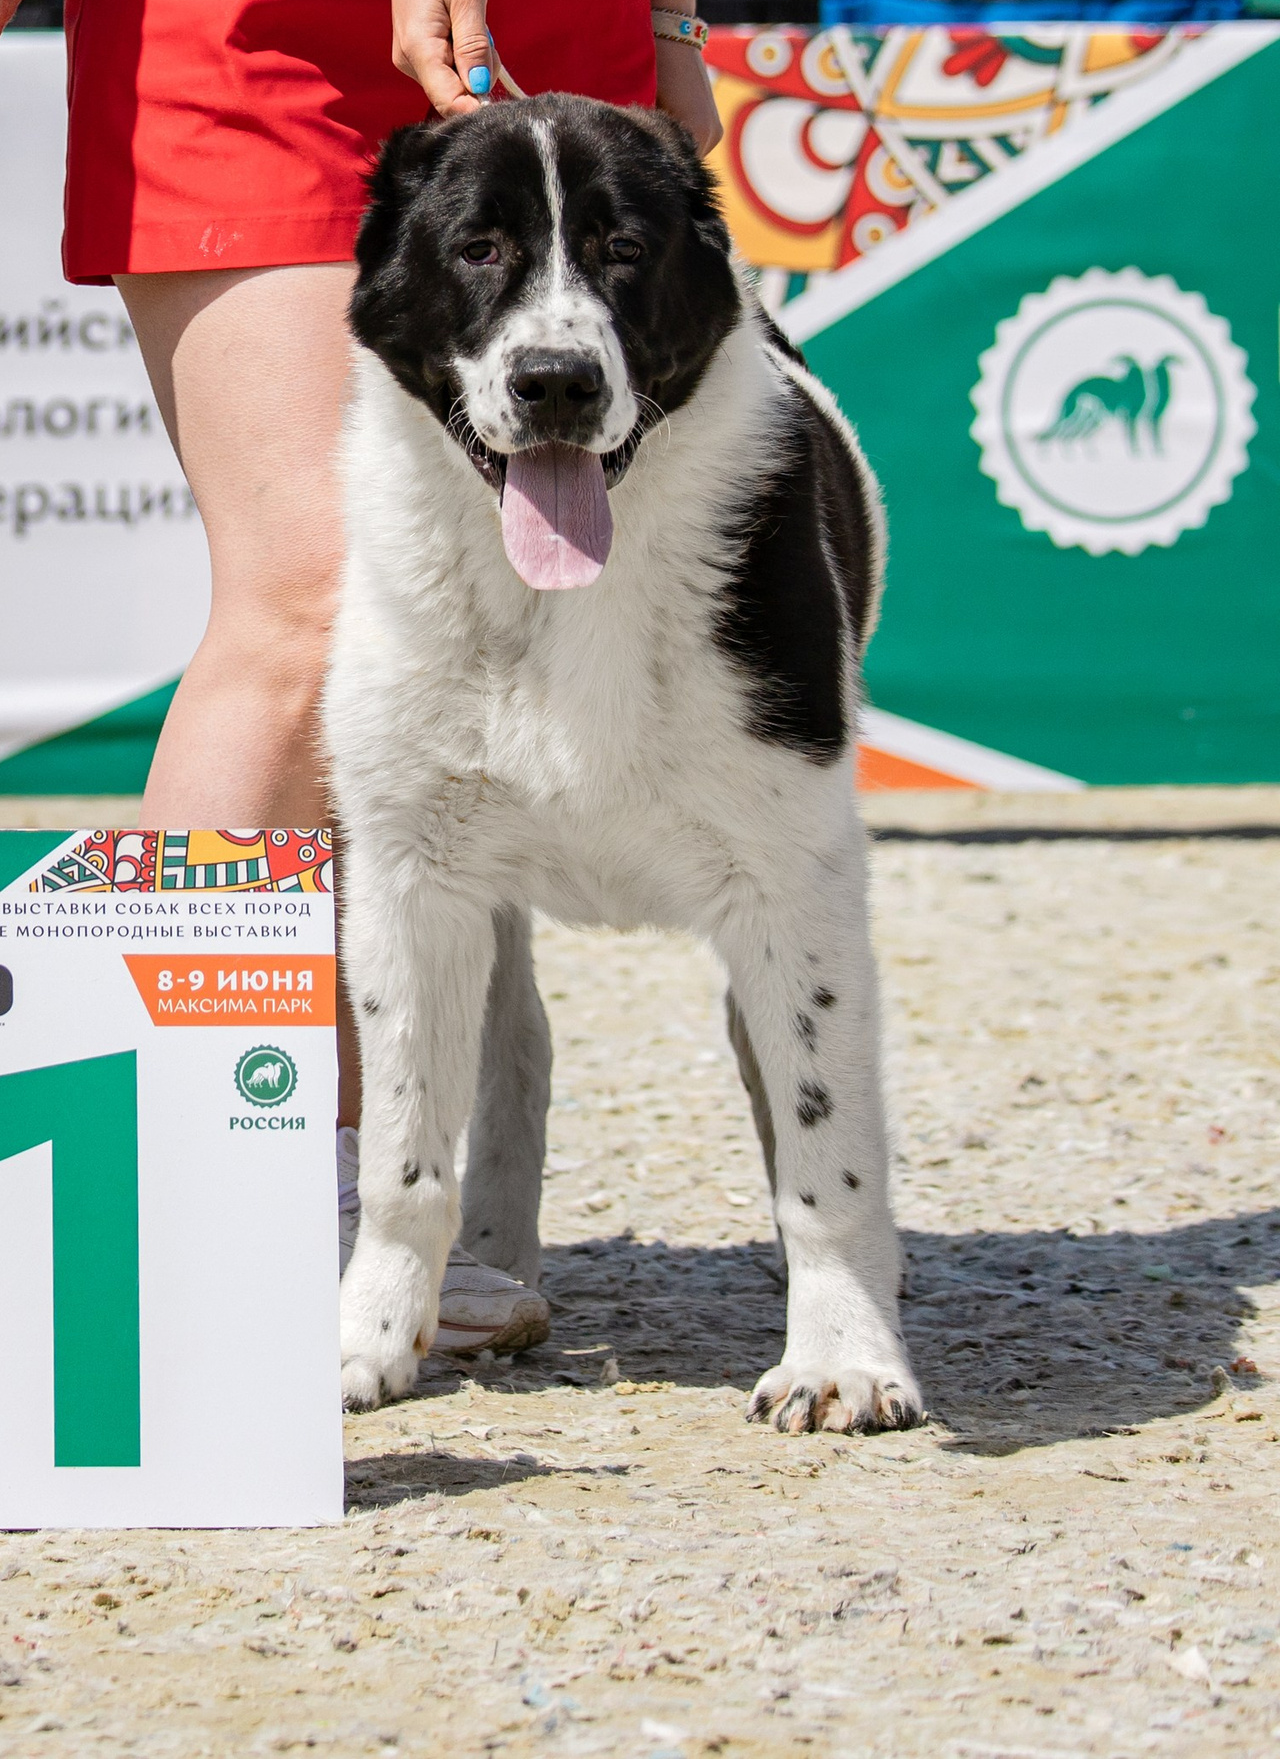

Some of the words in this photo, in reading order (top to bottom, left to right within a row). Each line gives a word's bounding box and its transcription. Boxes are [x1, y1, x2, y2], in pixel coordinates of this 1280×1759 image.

[2, 902, 106, 916] ВЫСТАВКИ
[115, 902, 180, 915] СОБАК
[188, 902, 236, 915] ВСЕХ
[245, 902, 311, 917] ПОРОД
[16, 925, 185, 940] МОНОПОРОДНЫЕ
[193, 925, 298, 938] ВЫСТАВКИ
[157, 970, 205, 991] 8-9
[217, 969, 313, 991] ИЮНЯ
[157, 998, 258, 1013] МАКСИМА
[263, 998, 313, 1013] ПАРК
[229, 1116, 306, 1130] РОССИЯ
